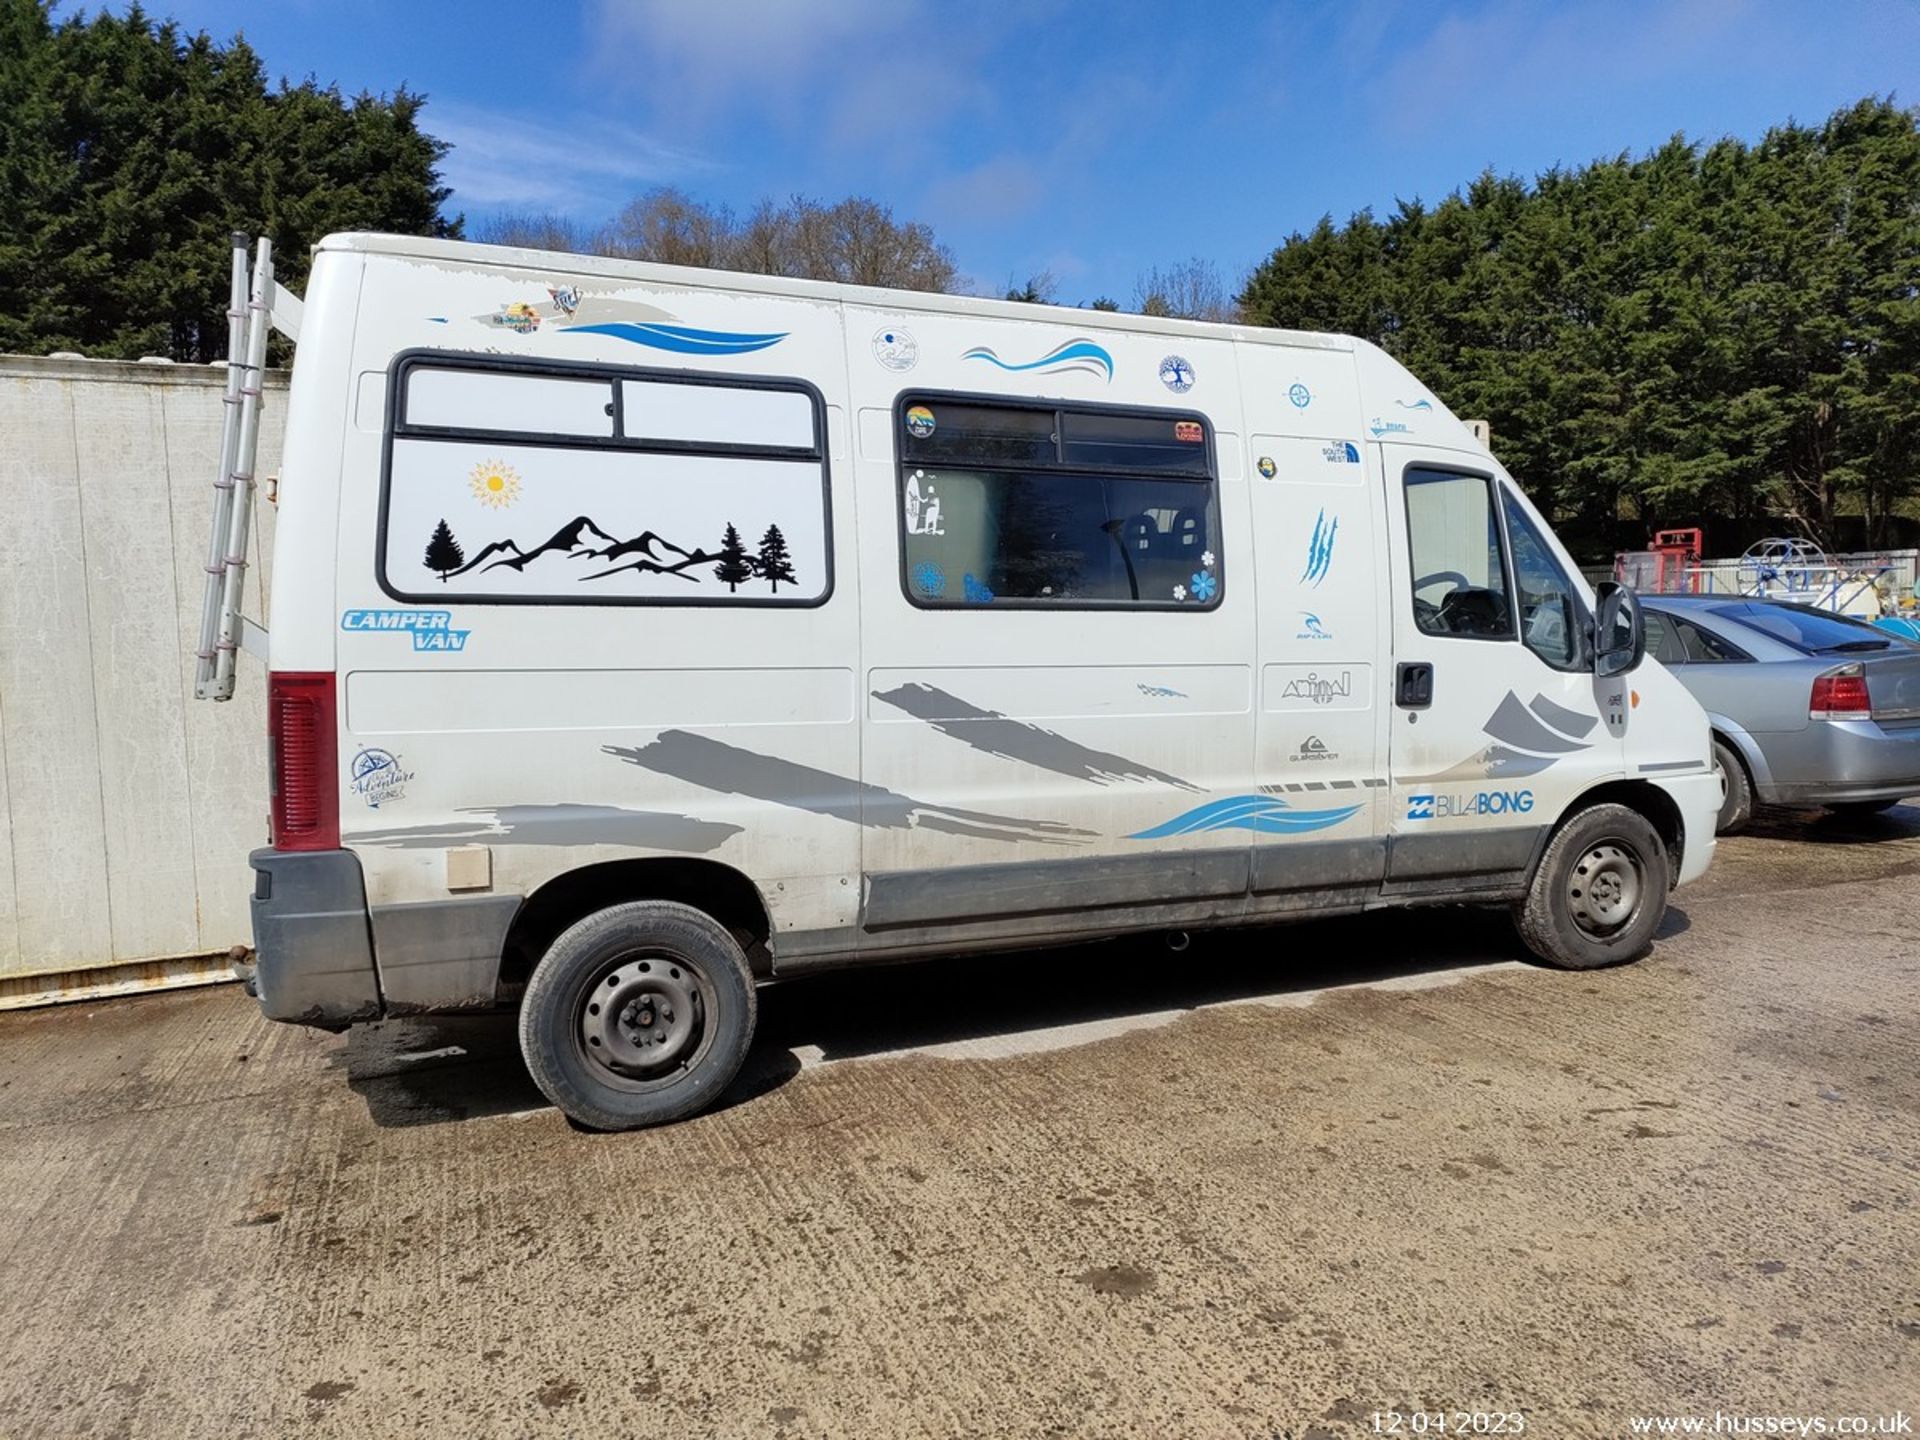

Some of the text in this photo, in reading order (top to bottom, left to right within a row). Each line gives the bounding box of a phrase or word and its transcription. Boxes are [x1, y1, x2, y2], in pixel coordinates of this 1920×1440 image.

[1331, 441, 1344, 449] THE
[1322, 448, 1346, 456] SOUTH
[1327, 455, 1346, 463] WEST
[343, 611, 449, 629] CAMPER
[415, 632, 463, 650] VAN
[1436, 790, 1534, 818] BILLABONG
